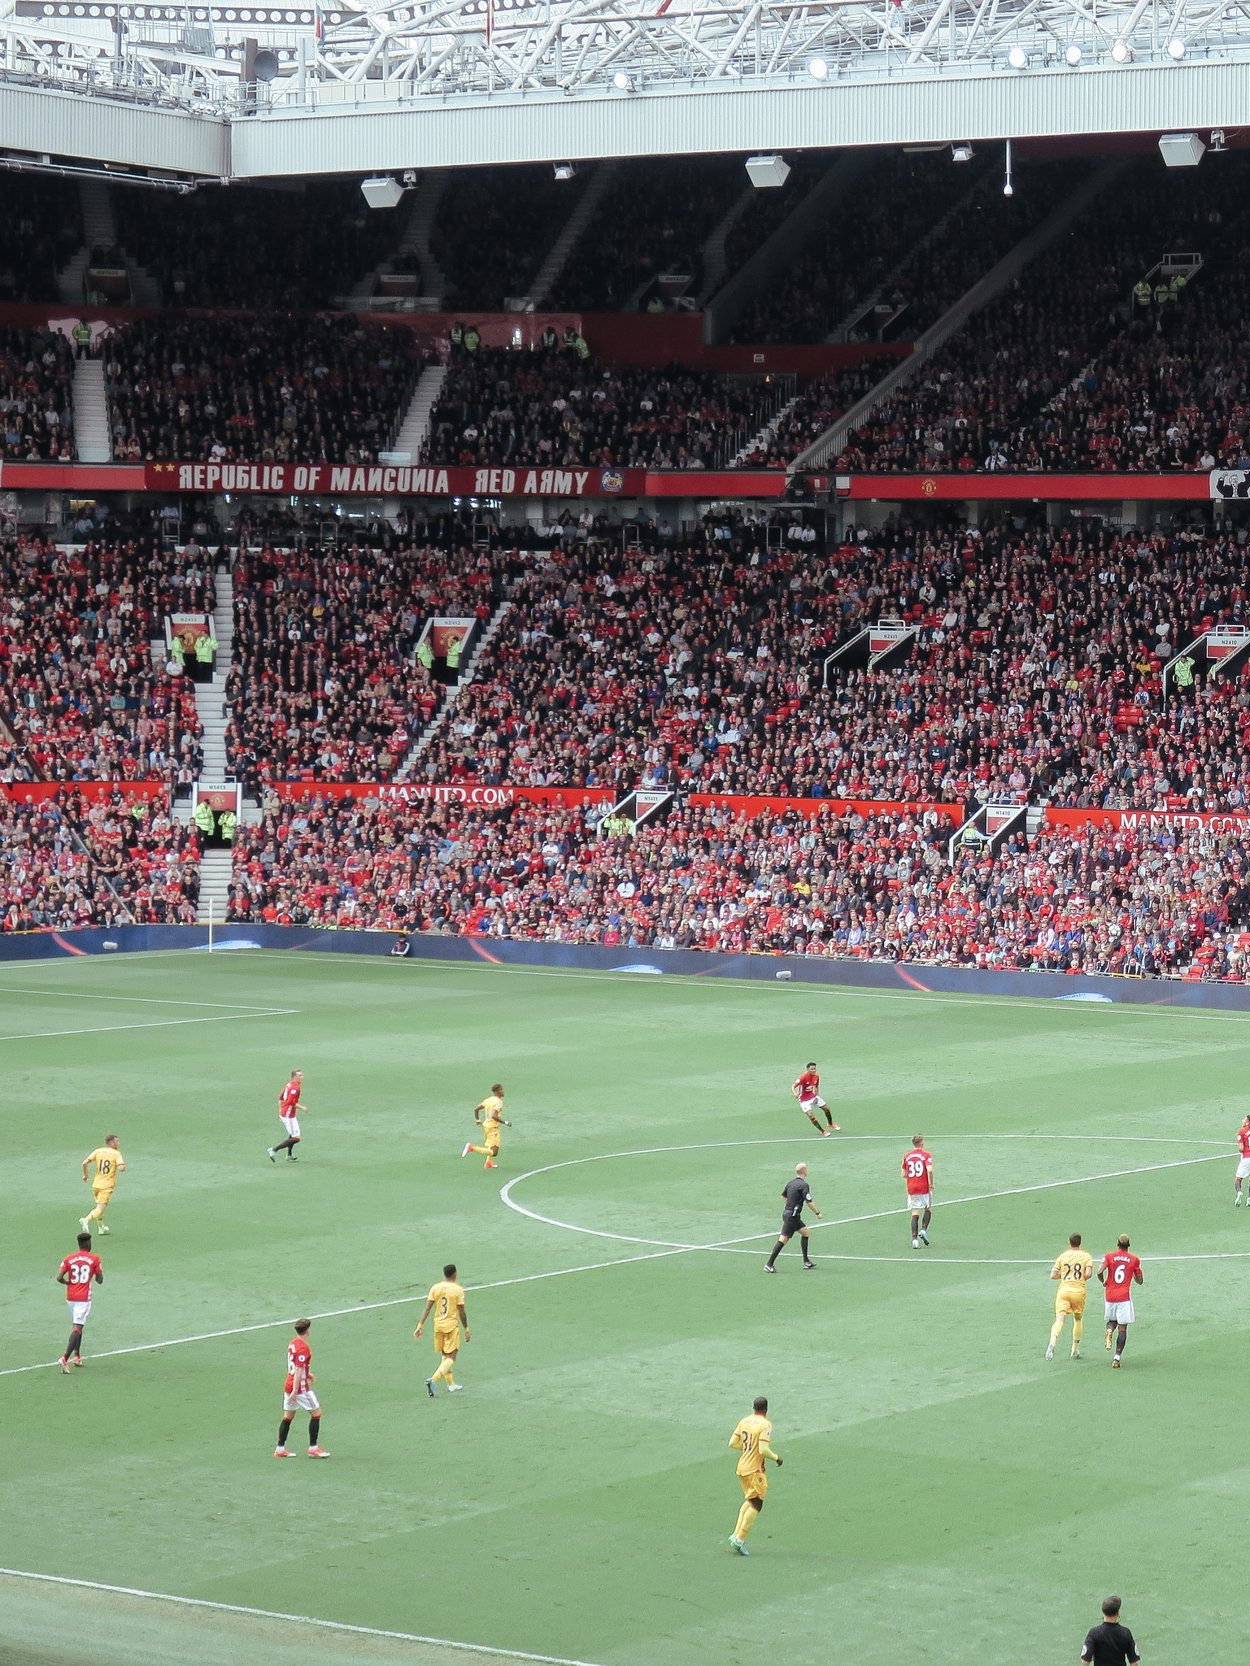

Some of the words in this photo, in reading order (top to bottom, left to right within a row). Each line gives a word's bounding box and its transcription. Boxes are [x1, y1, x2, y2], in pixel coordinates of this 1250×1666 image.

[293, 467, 321, 490] OF
[98, 1160, 111, 1175] 18
[907, 1160, 924, 1177] 39
[70, 1264, 90, 1284] 38
[1063, 1263, 1082, 1281] 28
[1114, 1265, 1125, 1284] 6
[440, 1297, 448, 1317] 3
